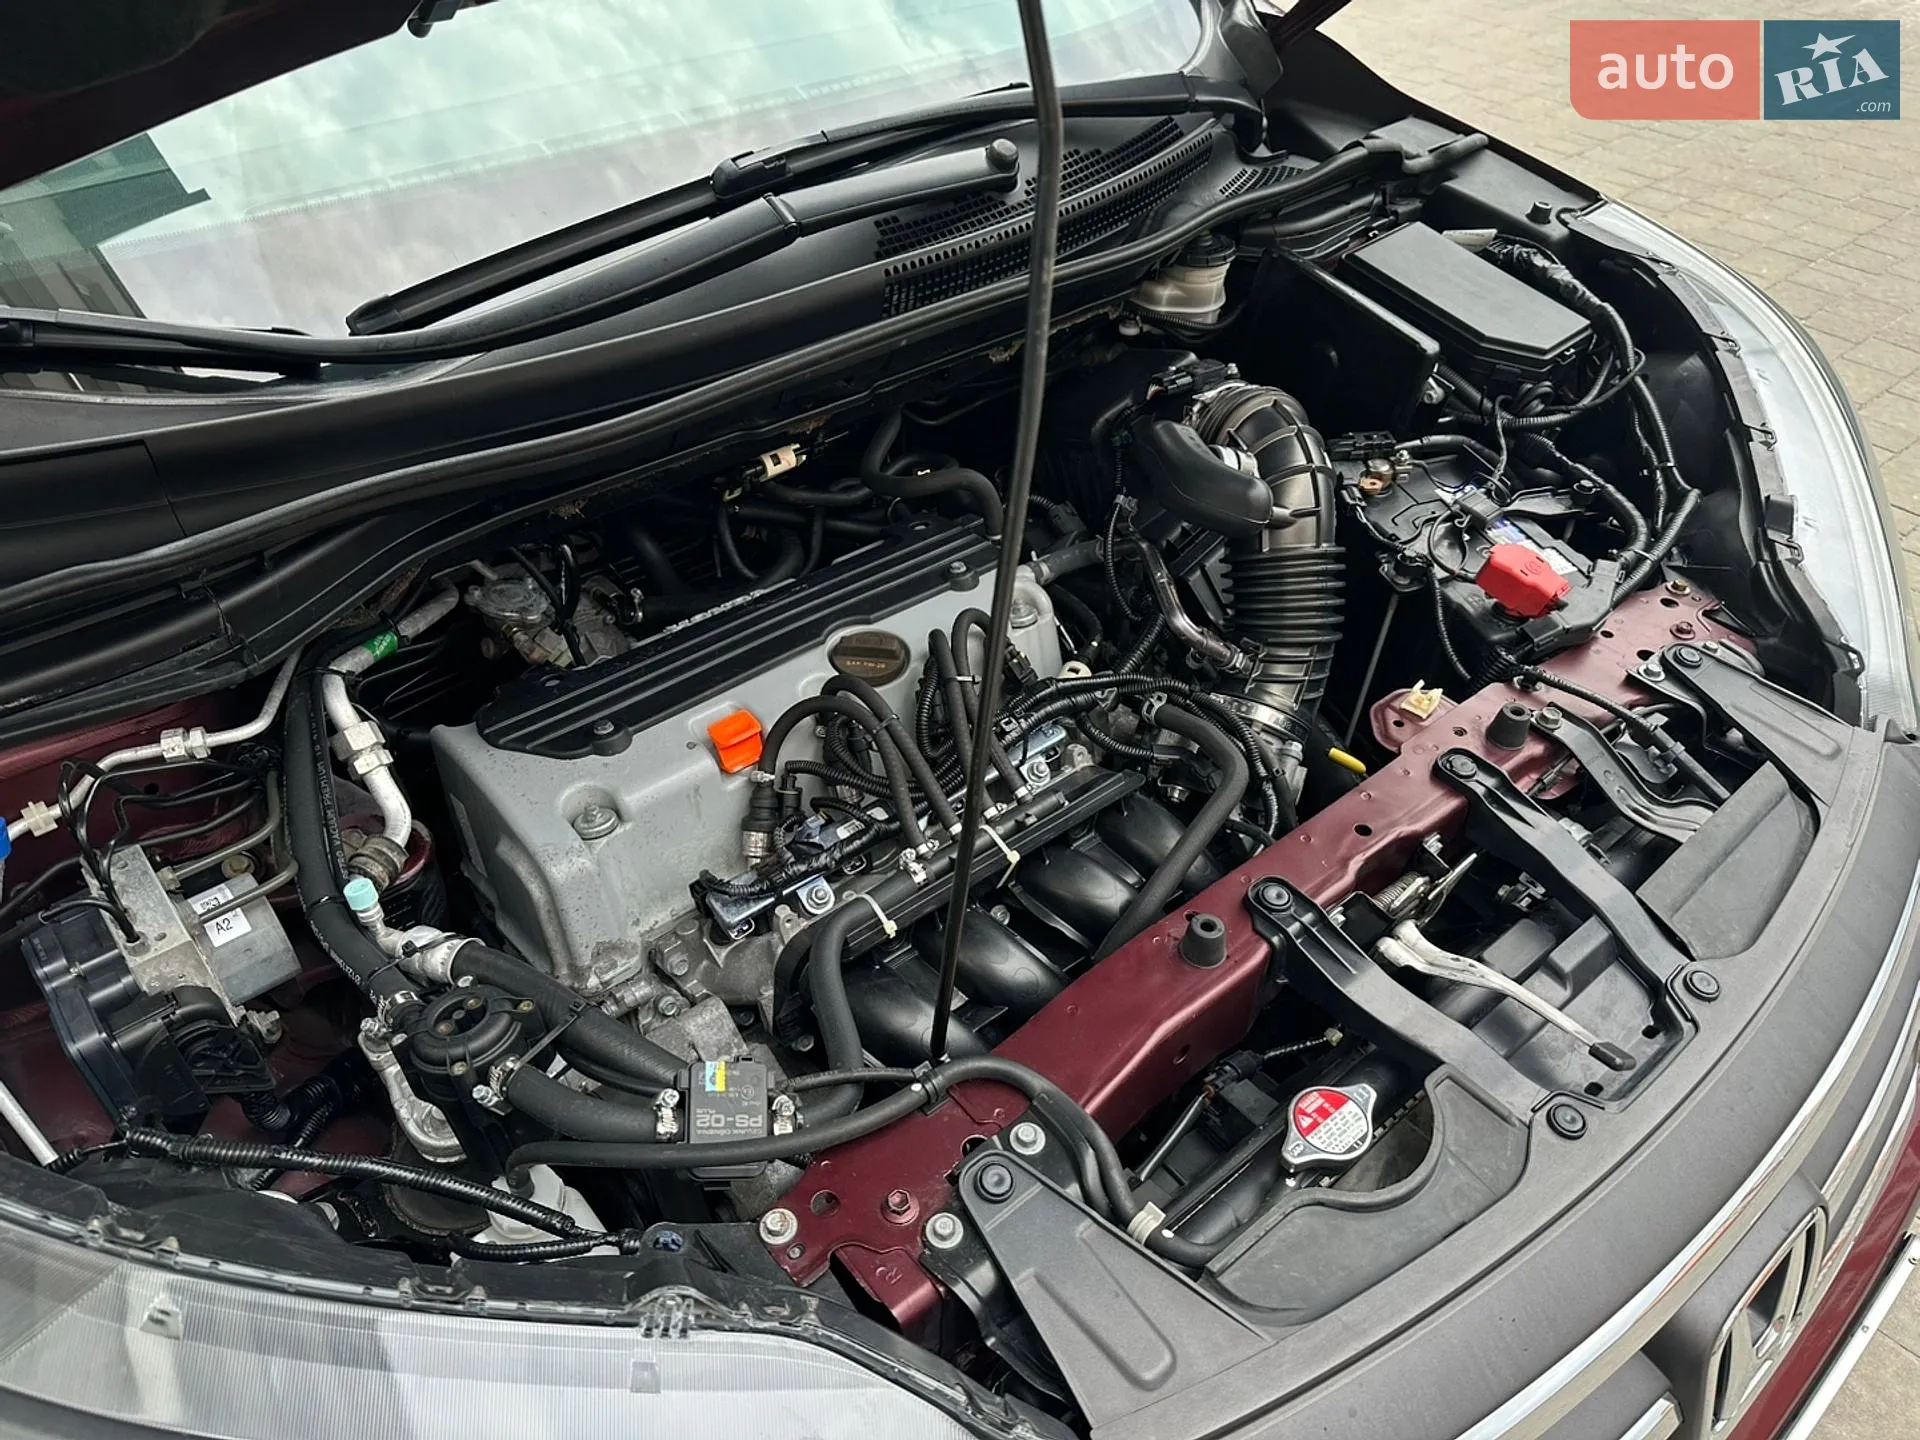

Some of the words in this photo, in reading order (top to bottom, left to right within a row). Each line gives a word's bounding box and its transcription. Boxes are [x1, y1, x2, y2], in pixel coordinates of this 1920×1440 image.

[317, 762, 333, 806] PREMIUM
[215, 917, 233, 935] A2
[696, 1114, 763, 1127] PS-02
